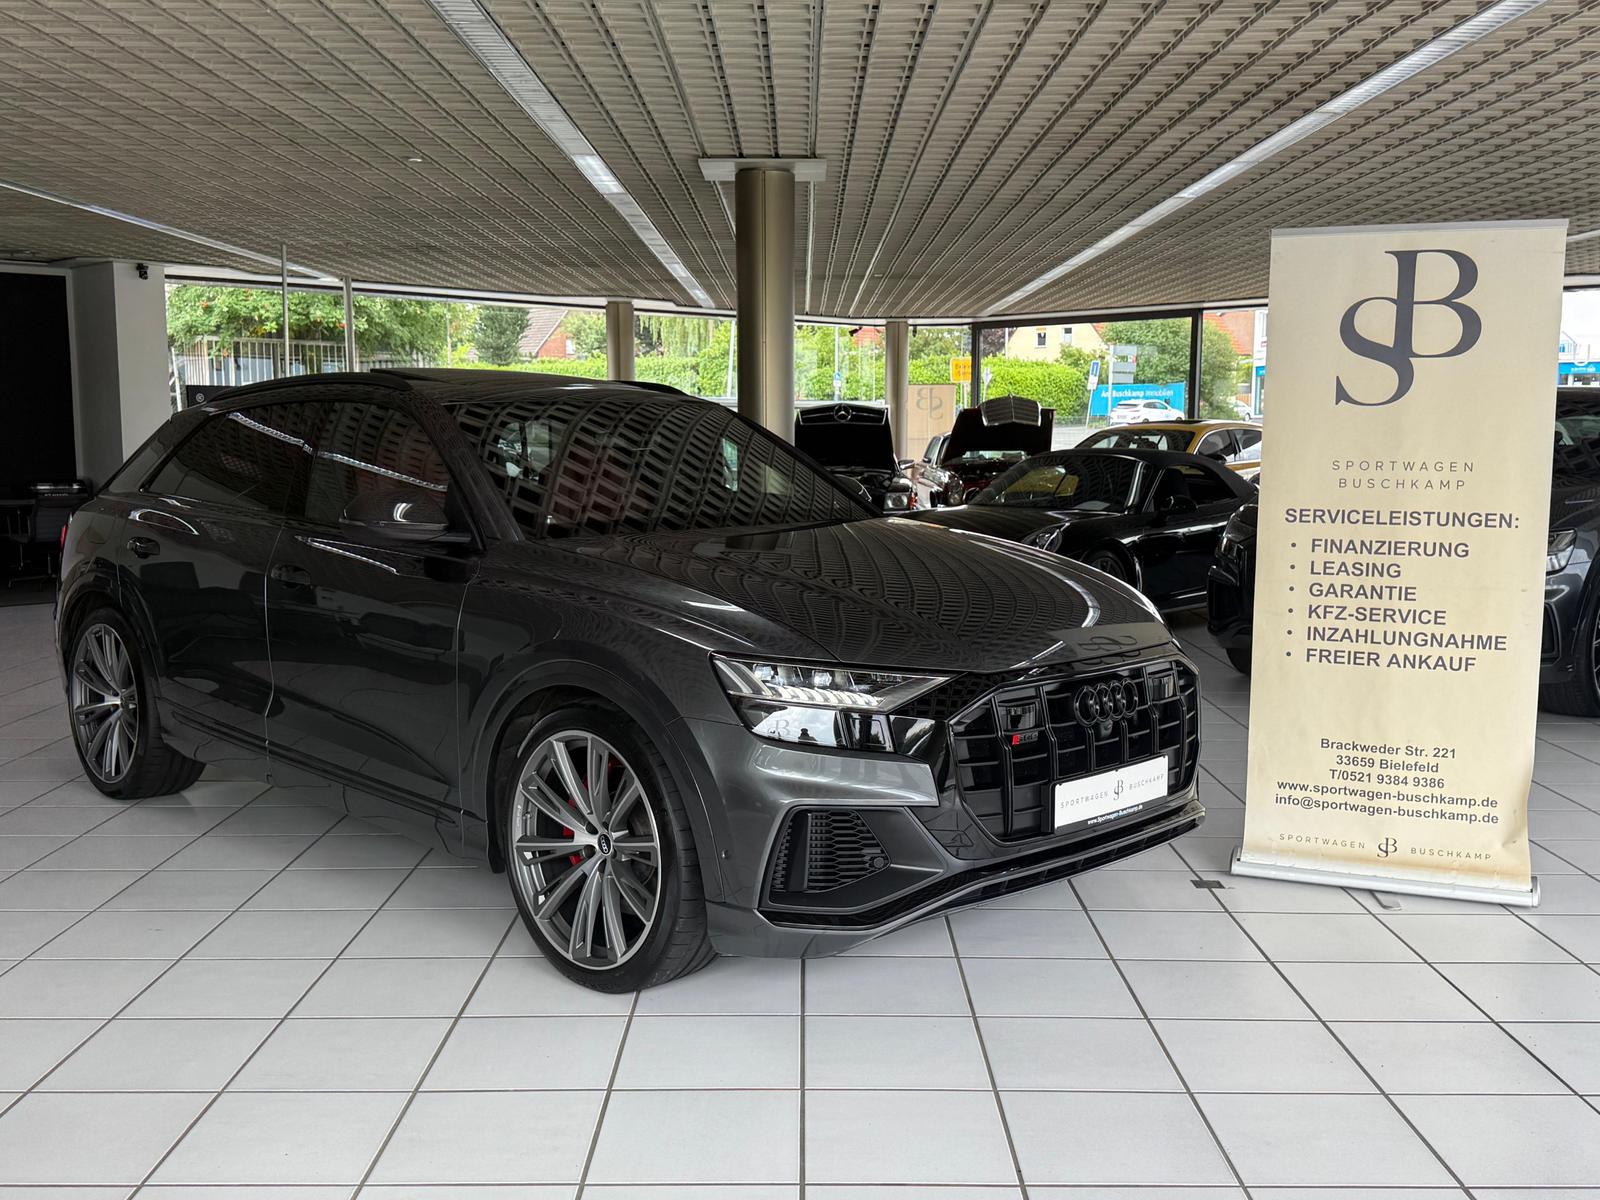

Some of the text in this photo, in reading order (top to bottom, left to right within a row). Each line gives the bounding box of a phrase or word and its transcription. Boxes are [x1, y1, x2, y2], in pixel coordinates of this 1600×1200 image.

[1332, 460, 1475, 473] SPORTWAGEN
[1338, 478, 1466, 491] BUSCHKAMP
[1285, 508, 1520, 529] SERVICELEISTUNGEN:
[1311, 538, 1470, 558] FINANZIERUNG
[1310, 560, 1402, 578] LEASING
[1309, 582, 1417, 602] GARANTIE
[1307, 604, 1447, 625] KFZ-SERVICE
[1306, 626, 1507, 651] INZAHLUNGNAHME
[1306, 648, 1477, 672] FREIER ANKAUF
[1320, 738, 1456, 759] Brackweder Str. 221
[1336, 754, 1439, 773] 33659 Bielefeld
[1329, 769, 1445, 789] T/0521 9384 9386
[1060, 790, 1109, 809] SPORTWAGEN
[1128, 774, 1164, 791] BUSCHKAMP
[1277, 780, 1498, 808] www.sportwagen-buschkamp.de
[1275, 794, 1499, 824] info@sportwagen-buschkamp.de
[1279, 833, 1366, 849] SPORTWAGEN
[1410, 846, 1492, 861] BUSCHKAMP
